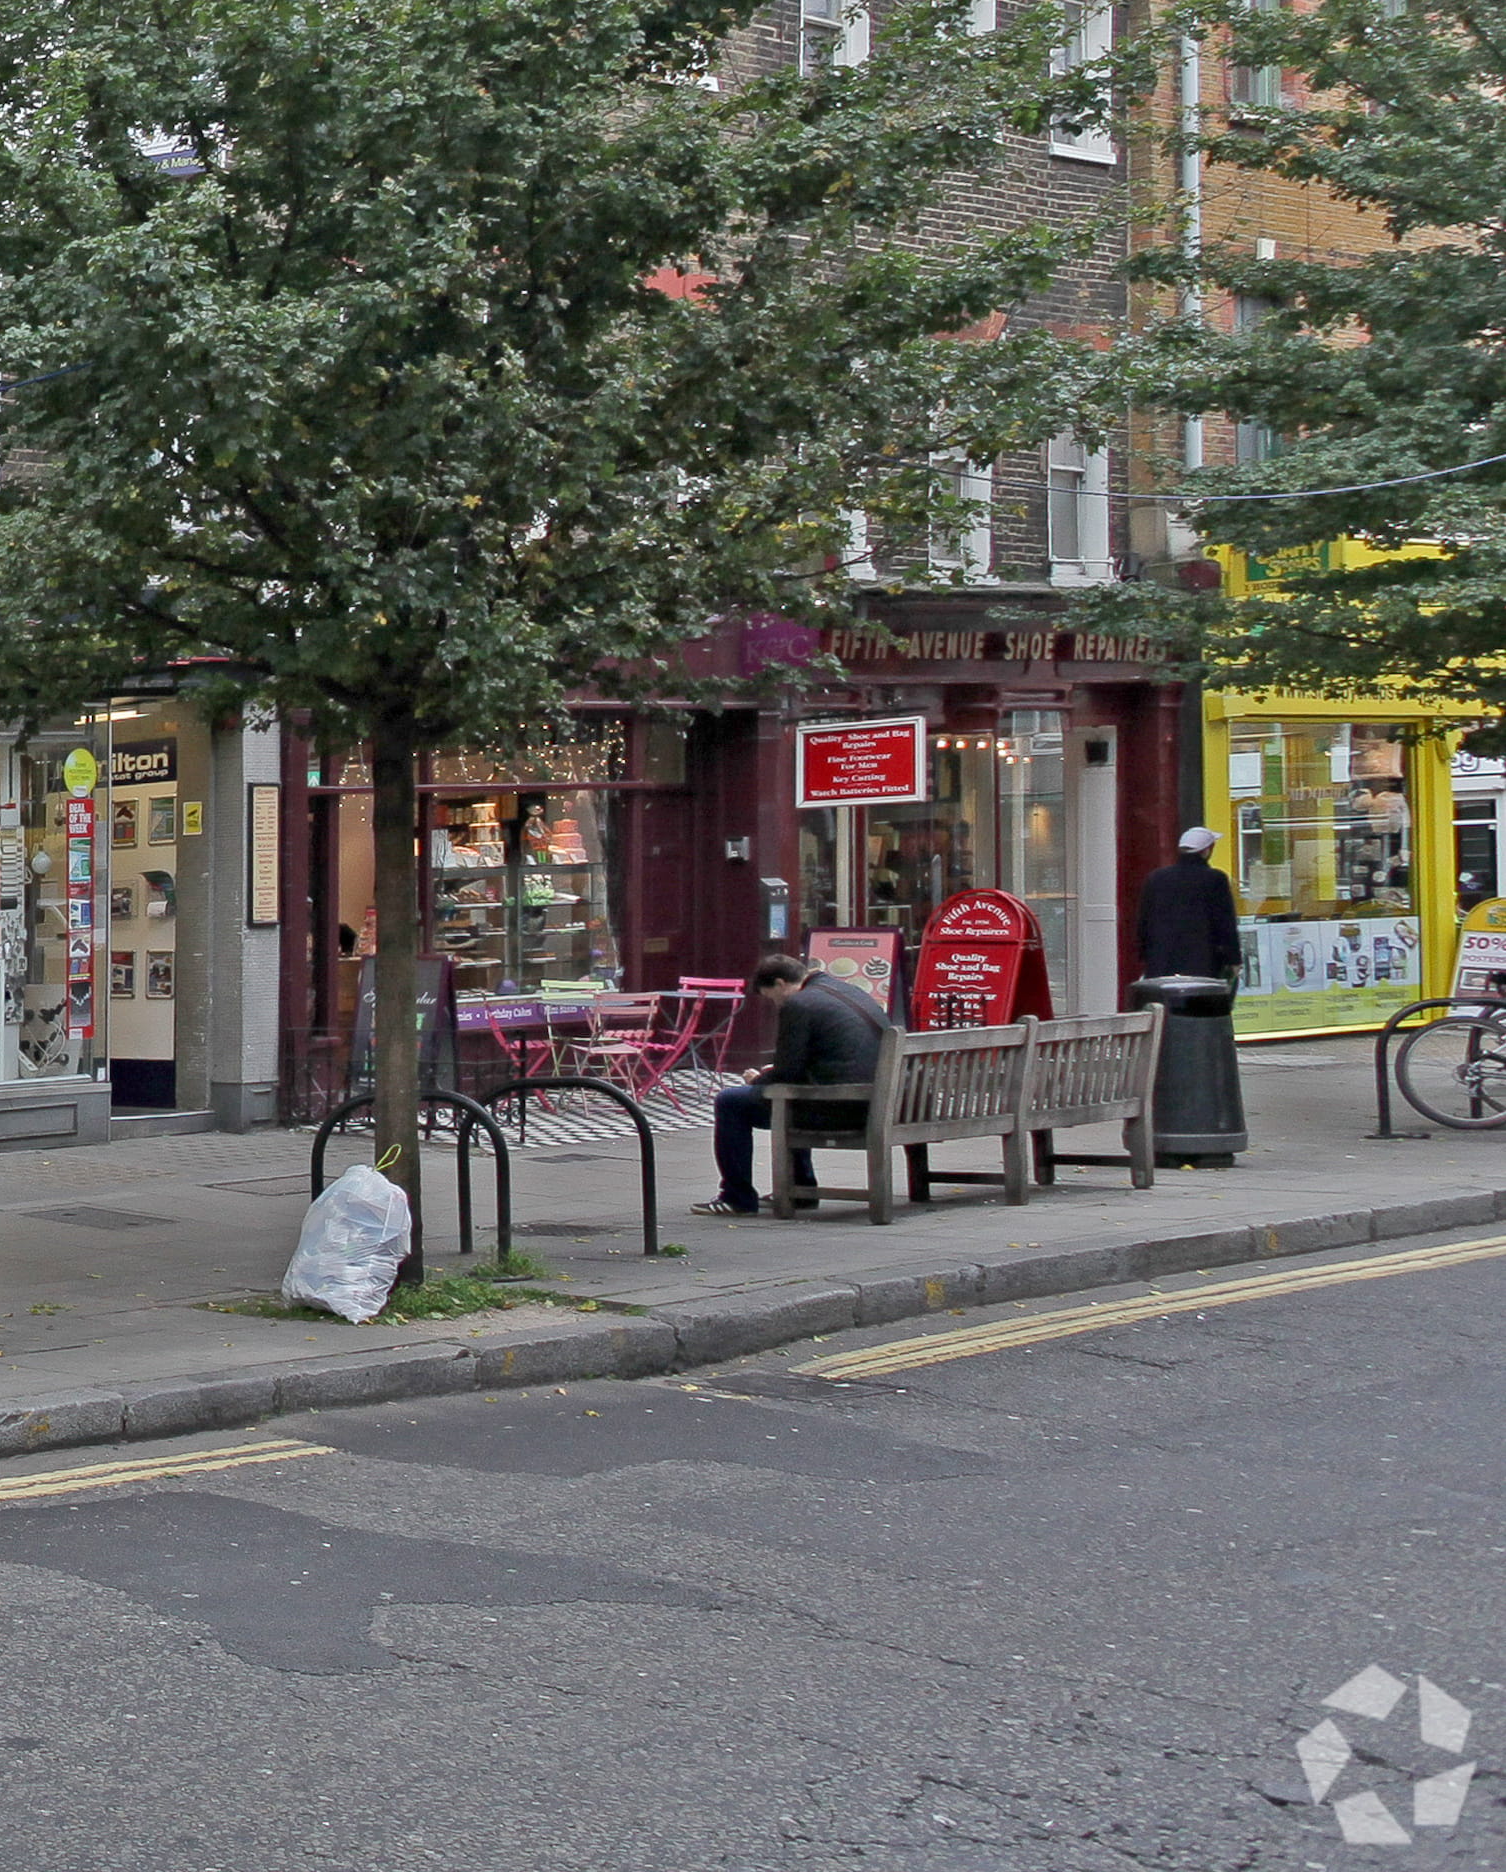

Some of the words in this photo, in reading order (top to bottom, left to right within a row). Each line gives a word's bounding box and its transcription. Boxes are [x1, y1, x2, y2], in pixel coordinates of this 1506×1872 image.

[831, 628, 889, 660] FIFTH
[907, 631, 986, 660] AVENUE
[1004, 631, 1054, 661] SHOE
[809, 735, 843, 745] Quality
[847, 732, 870, 740] Shoe
[872, 731, 890, 739] and
[892, 729, 910, 738] Bag
[842, 741, 877, 749] Repairs
[849, 753, 892, 762] Footwear
[832, 775, 849, 784] Key
[851, 774, 886, 782] Cutting
[810, 789, 838, 797] Watch
[839, 786, 880, 796] Batteries
[882, 784, 909, 793] Fitted
[69, 814, 78, 823] OF
[79, 813, 91, 823] THE
[941, 903, 970, 925] Fifth
[972, 900, 1012, 926] Avenue
[939, 927, 963, 935] Shoe
[964, 928, 1009, 937] Repairers
[951, 953, 988, 963] Quality
[934, 962, 959, 971] Shoe
[961, 963, 979, 971] and
[982, 964, 1001, 973] Bag
[947, 973, 985, 982] Repairs
